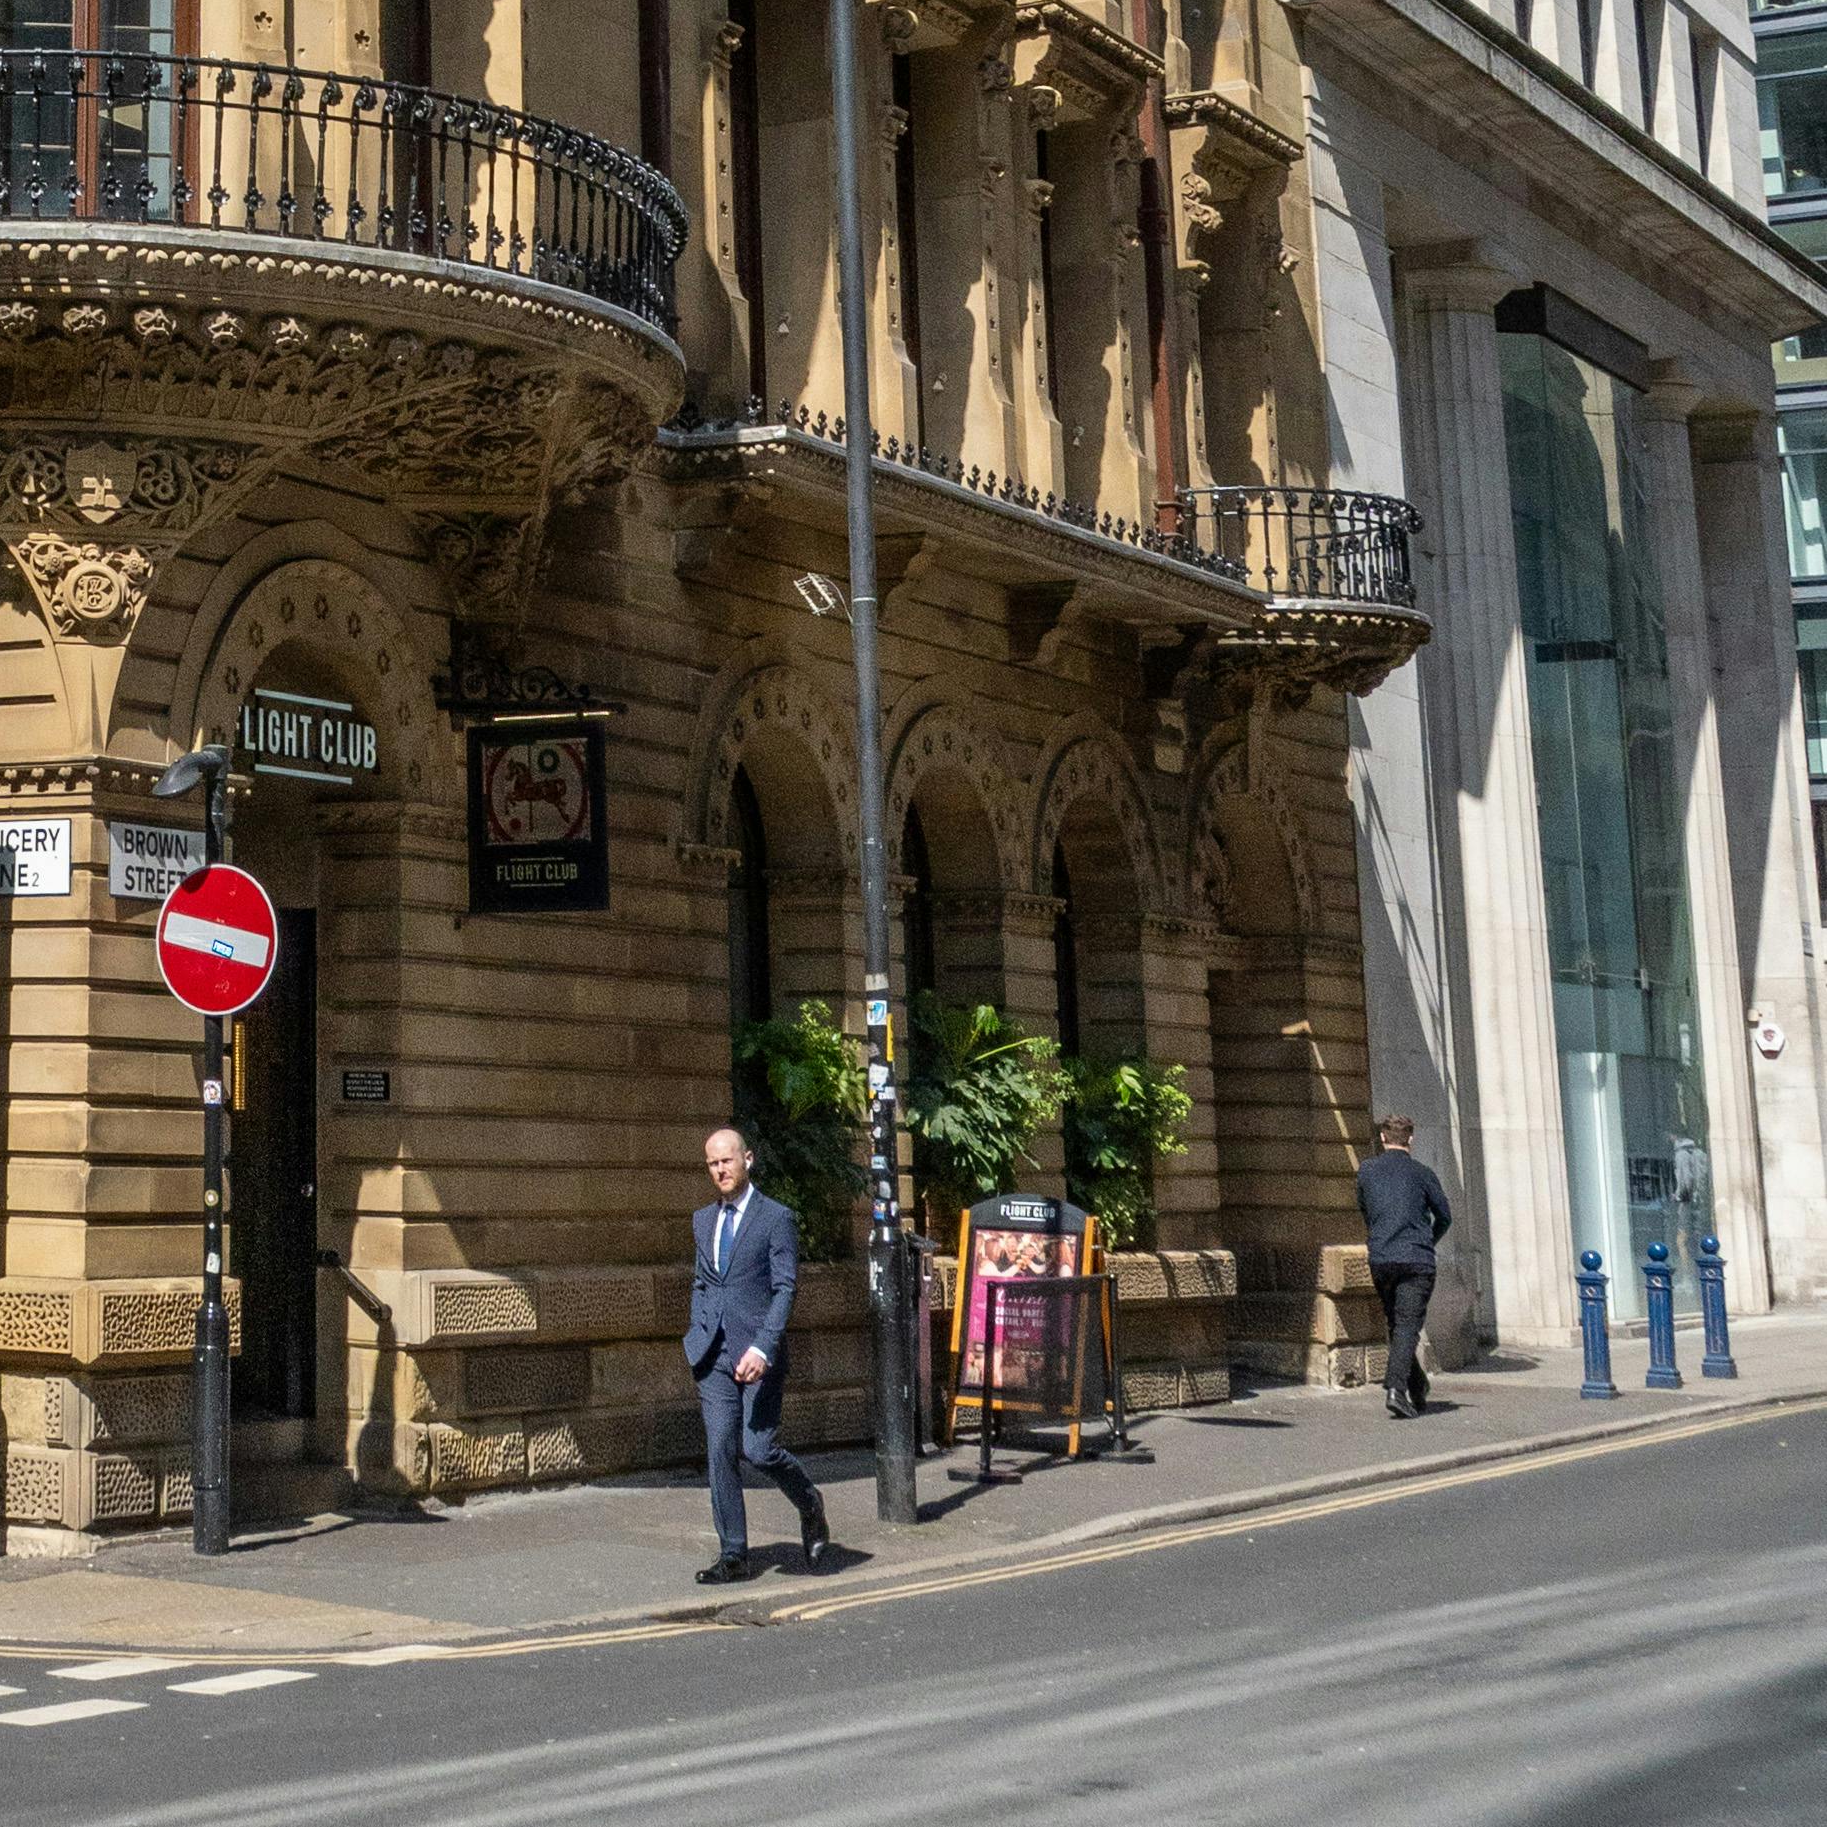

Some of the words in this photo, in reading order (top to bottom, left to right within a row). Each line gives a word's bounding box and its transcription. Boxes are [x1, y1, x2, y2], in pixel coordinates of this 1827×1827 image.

[234, 704, 312, 759] LIGHT
[320, 717, 377, 769] CLUB
[123, 828, 188, 860] BROWN
[31, 872, 40, 887] 2
[496, 864, 541, 882] FLIGHT
[545, 862, 578, 880] CLUB
[1000, 1204, 1032, 1217] FLIGHT
[1032, 1205, 1056, 1219] CLUB
